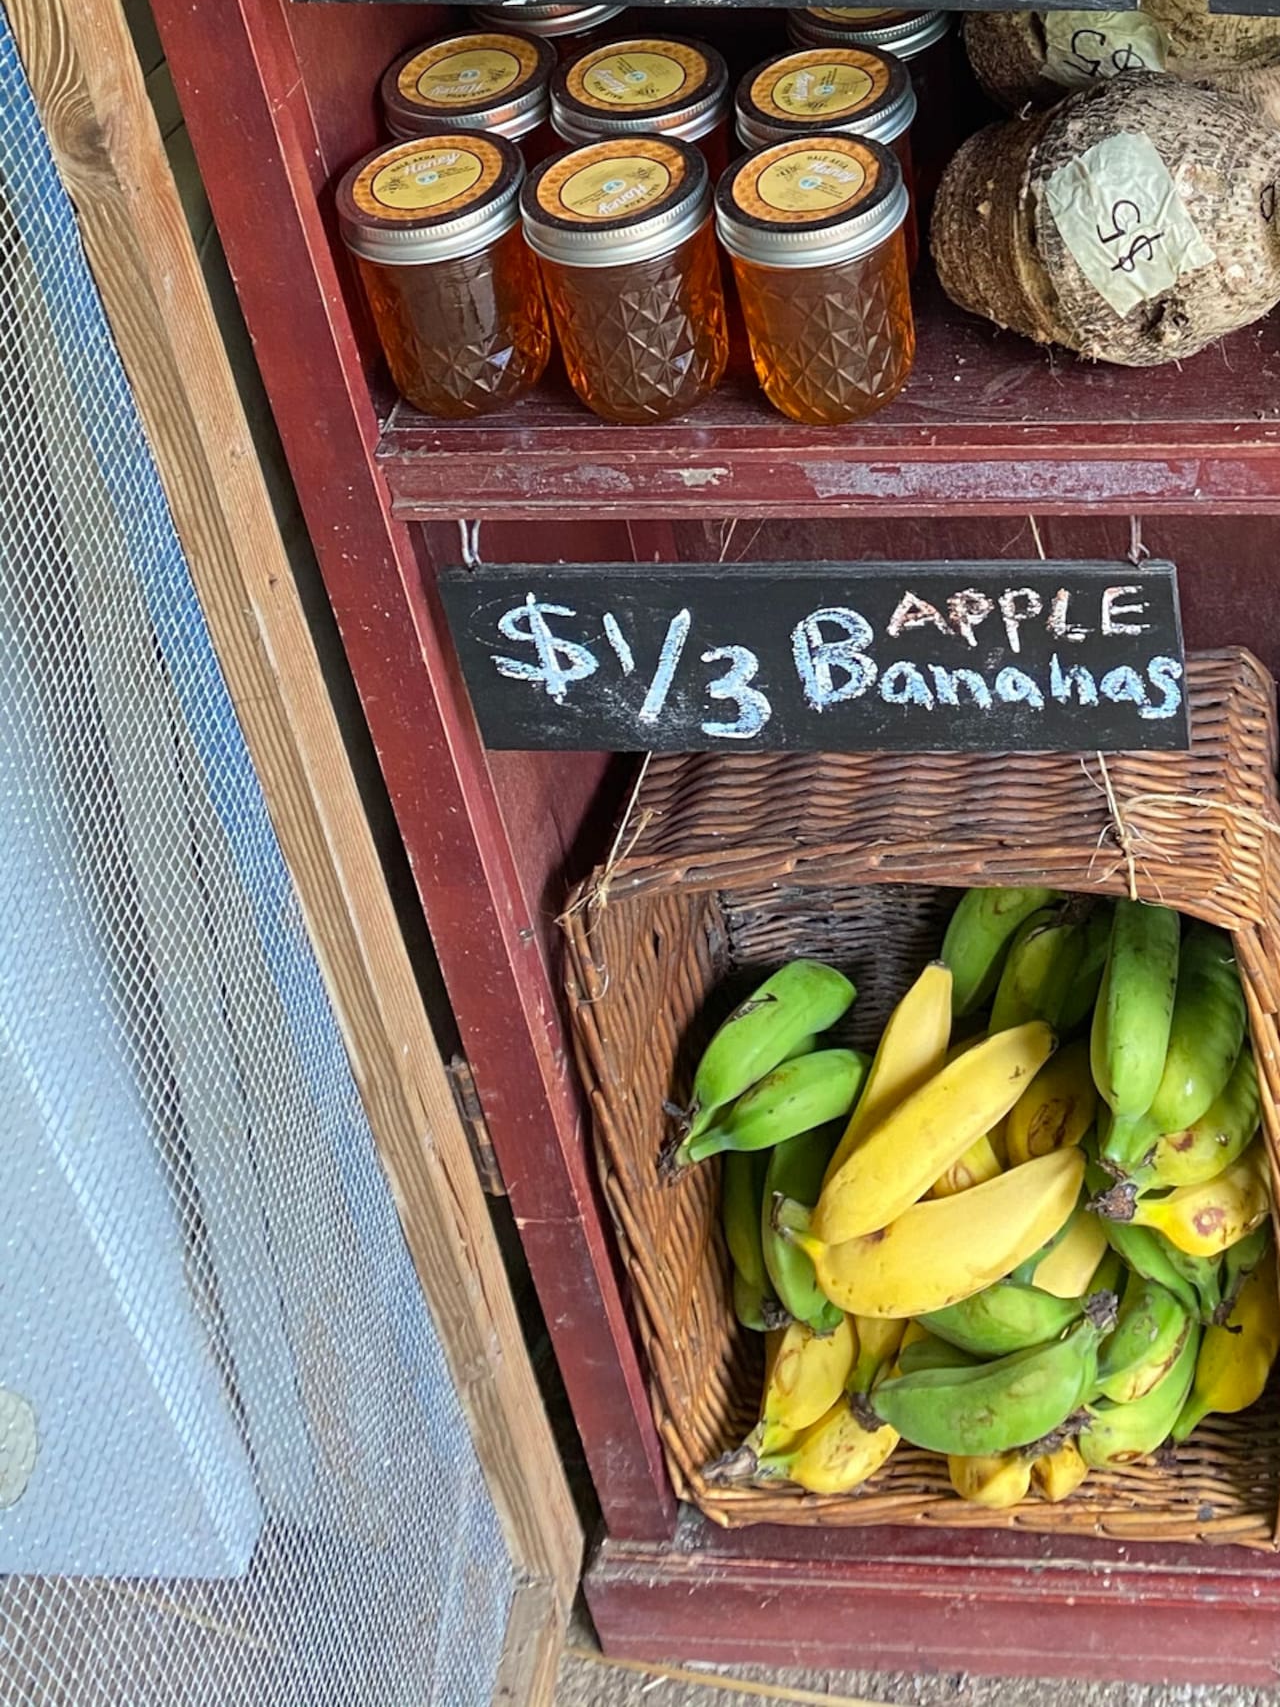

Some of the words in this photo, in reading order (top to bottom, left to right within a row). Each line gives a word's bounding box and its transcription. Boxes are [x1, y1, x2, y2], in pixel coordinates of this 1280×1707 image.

[404, 152, 462, 177] Honey
[1096, 199, 1165, 273] $5
[886, 585, 1151, 653] APPLE
[490, 591, 772, 740] $1/3
[791, 606, 1184, 720] Bananas
